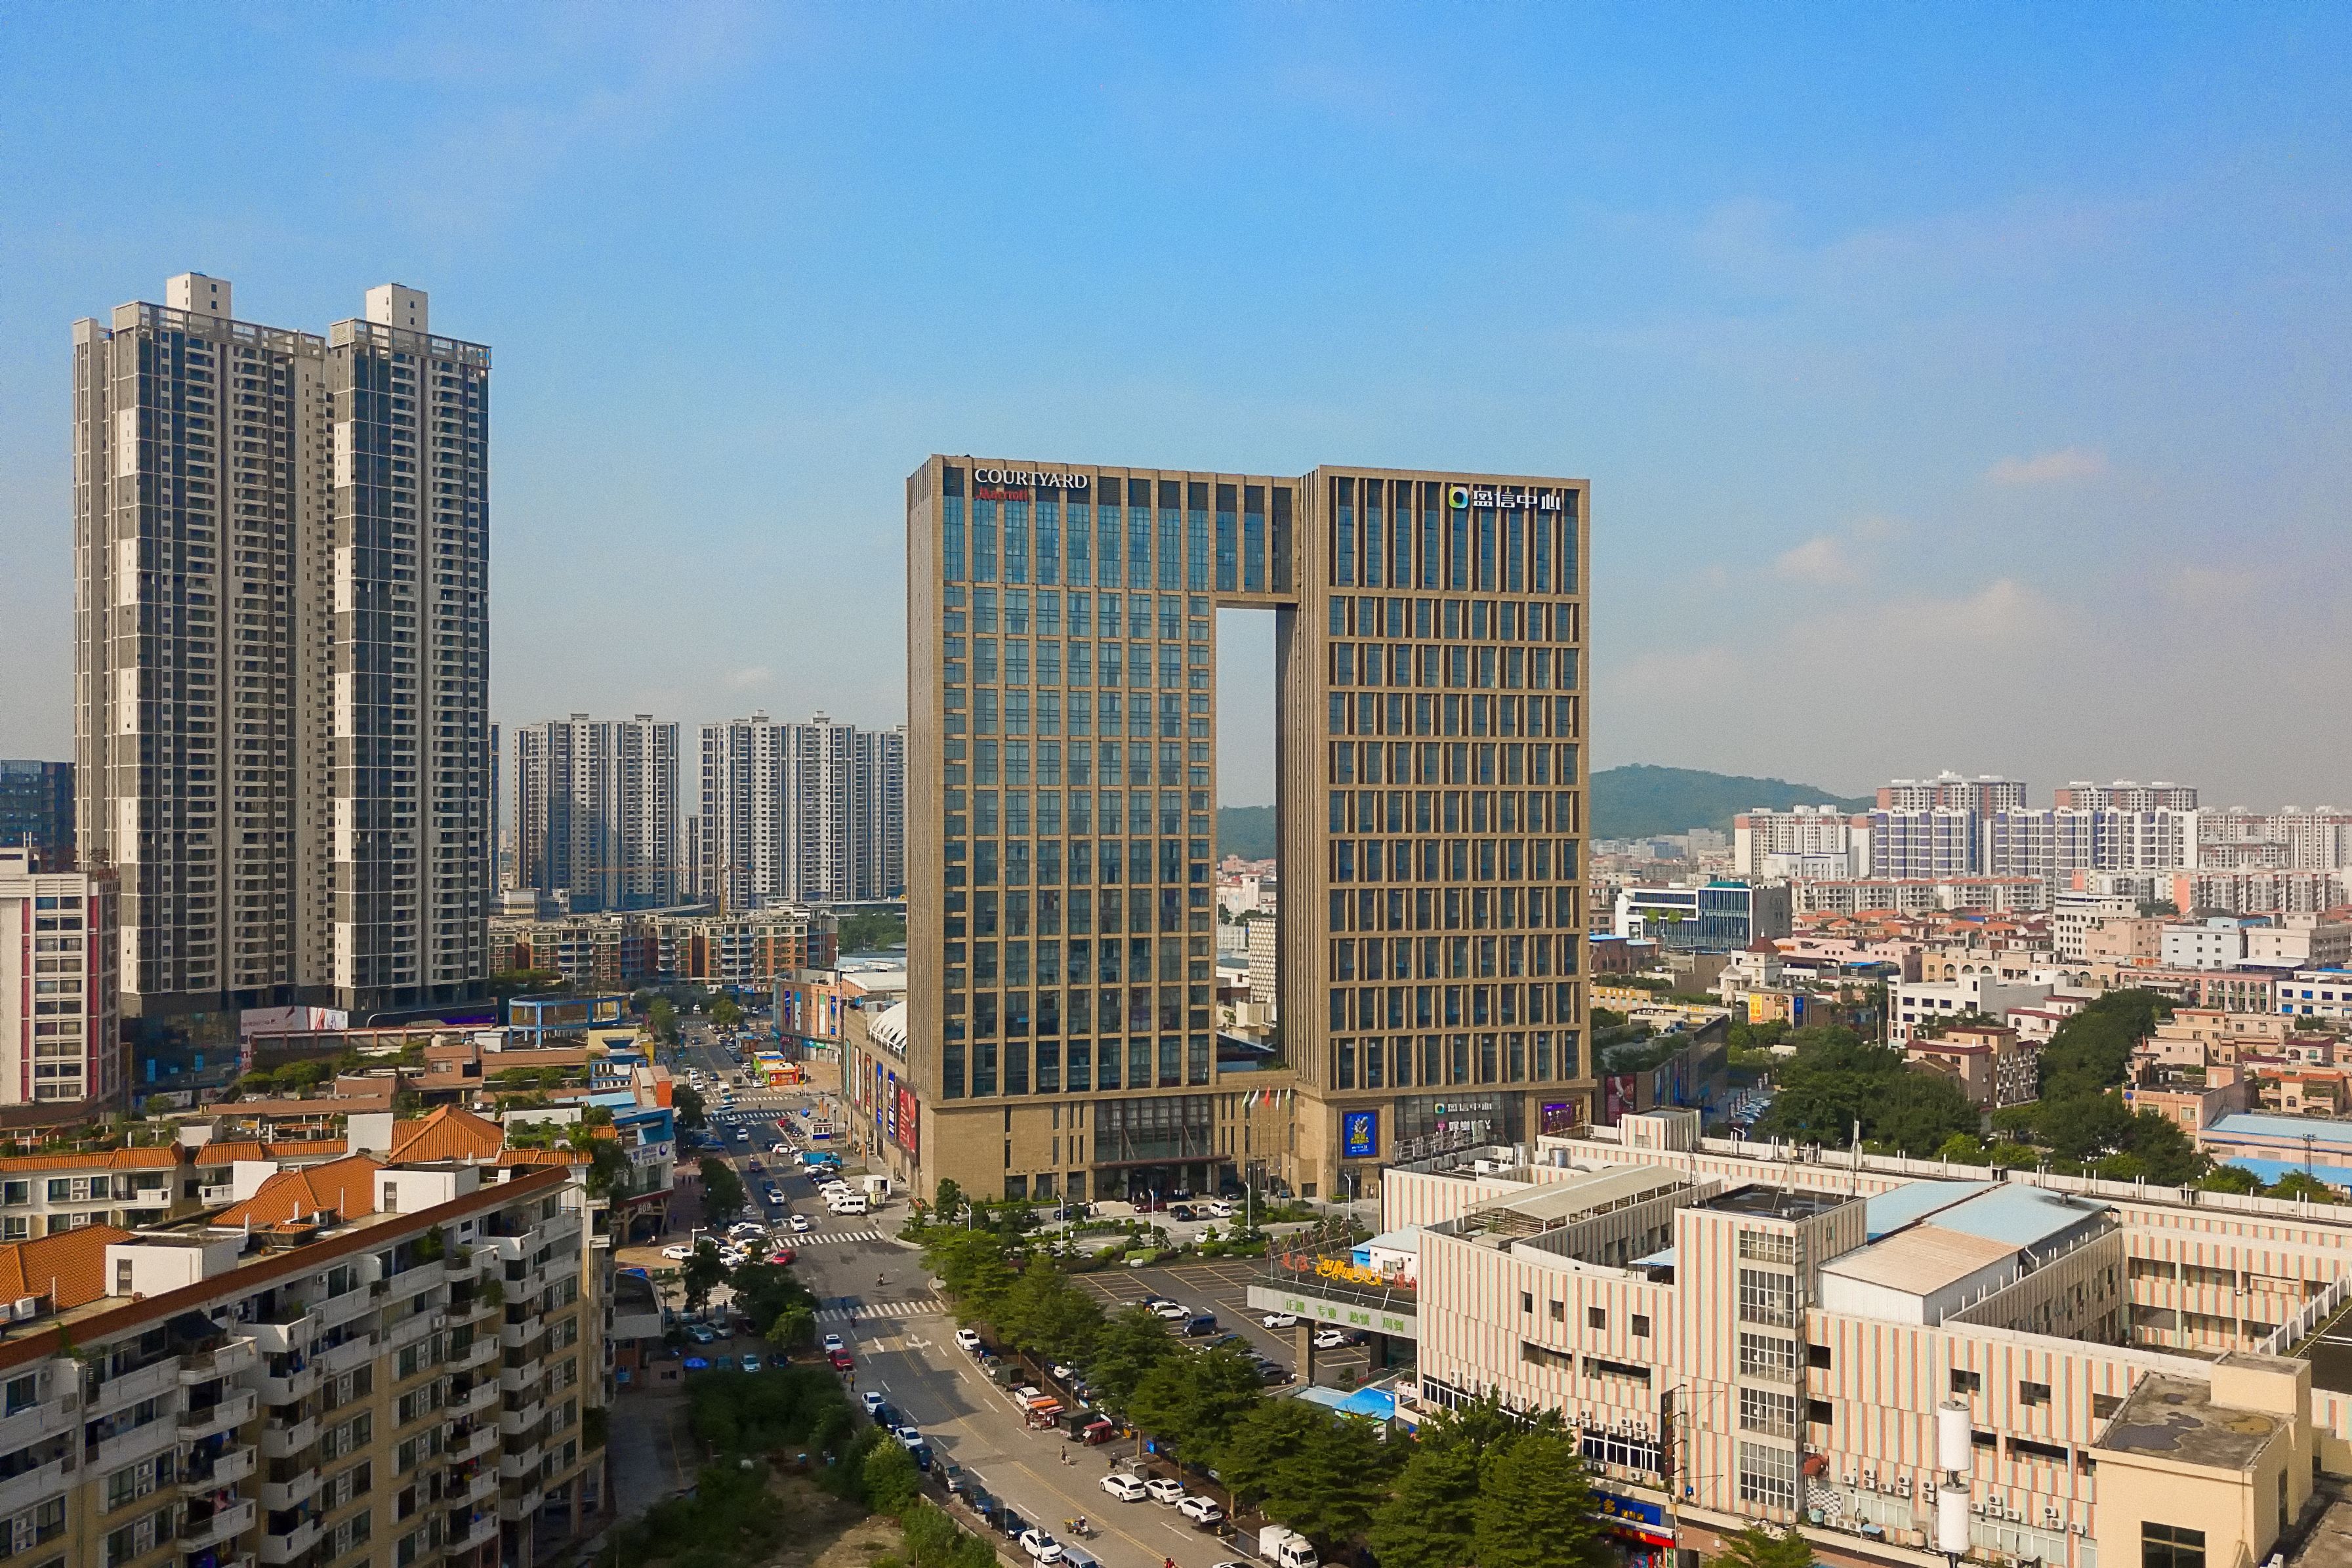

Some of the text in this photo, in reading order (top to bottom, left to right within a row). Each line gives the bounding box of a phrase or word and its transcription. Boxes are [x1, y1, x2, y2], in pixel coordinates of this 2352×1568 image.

[974, 468, 1088, 489] COURTYARD
[976, 485, 1029, 501] Marriott
[1473, 490, 1561, 510] 盈信中心
